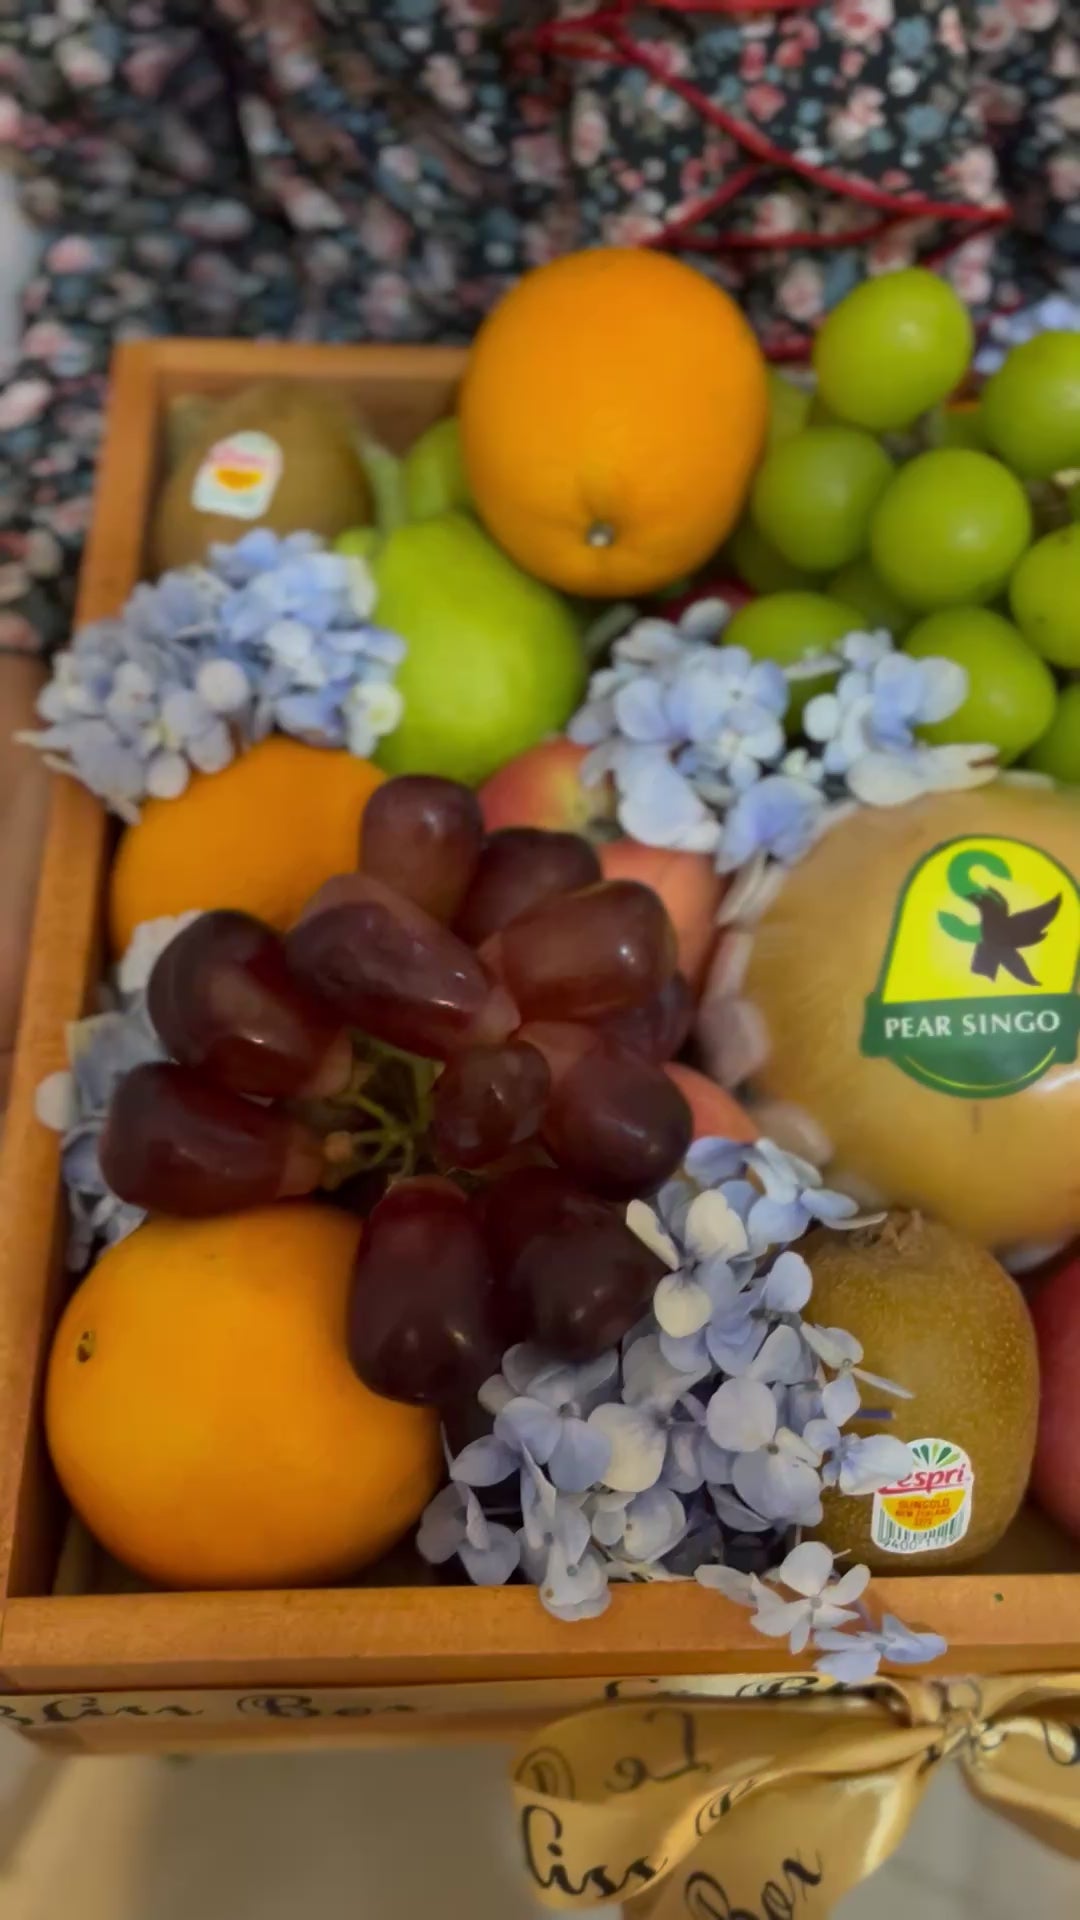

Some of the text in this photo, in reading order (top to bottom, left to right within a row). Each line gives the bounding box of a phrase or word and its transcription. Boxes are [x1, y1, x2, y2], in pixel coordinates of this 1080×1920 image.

[884, 1010, 1060, 1039] PEAR SINGO
[879, 1464, 966, 1493] espri
